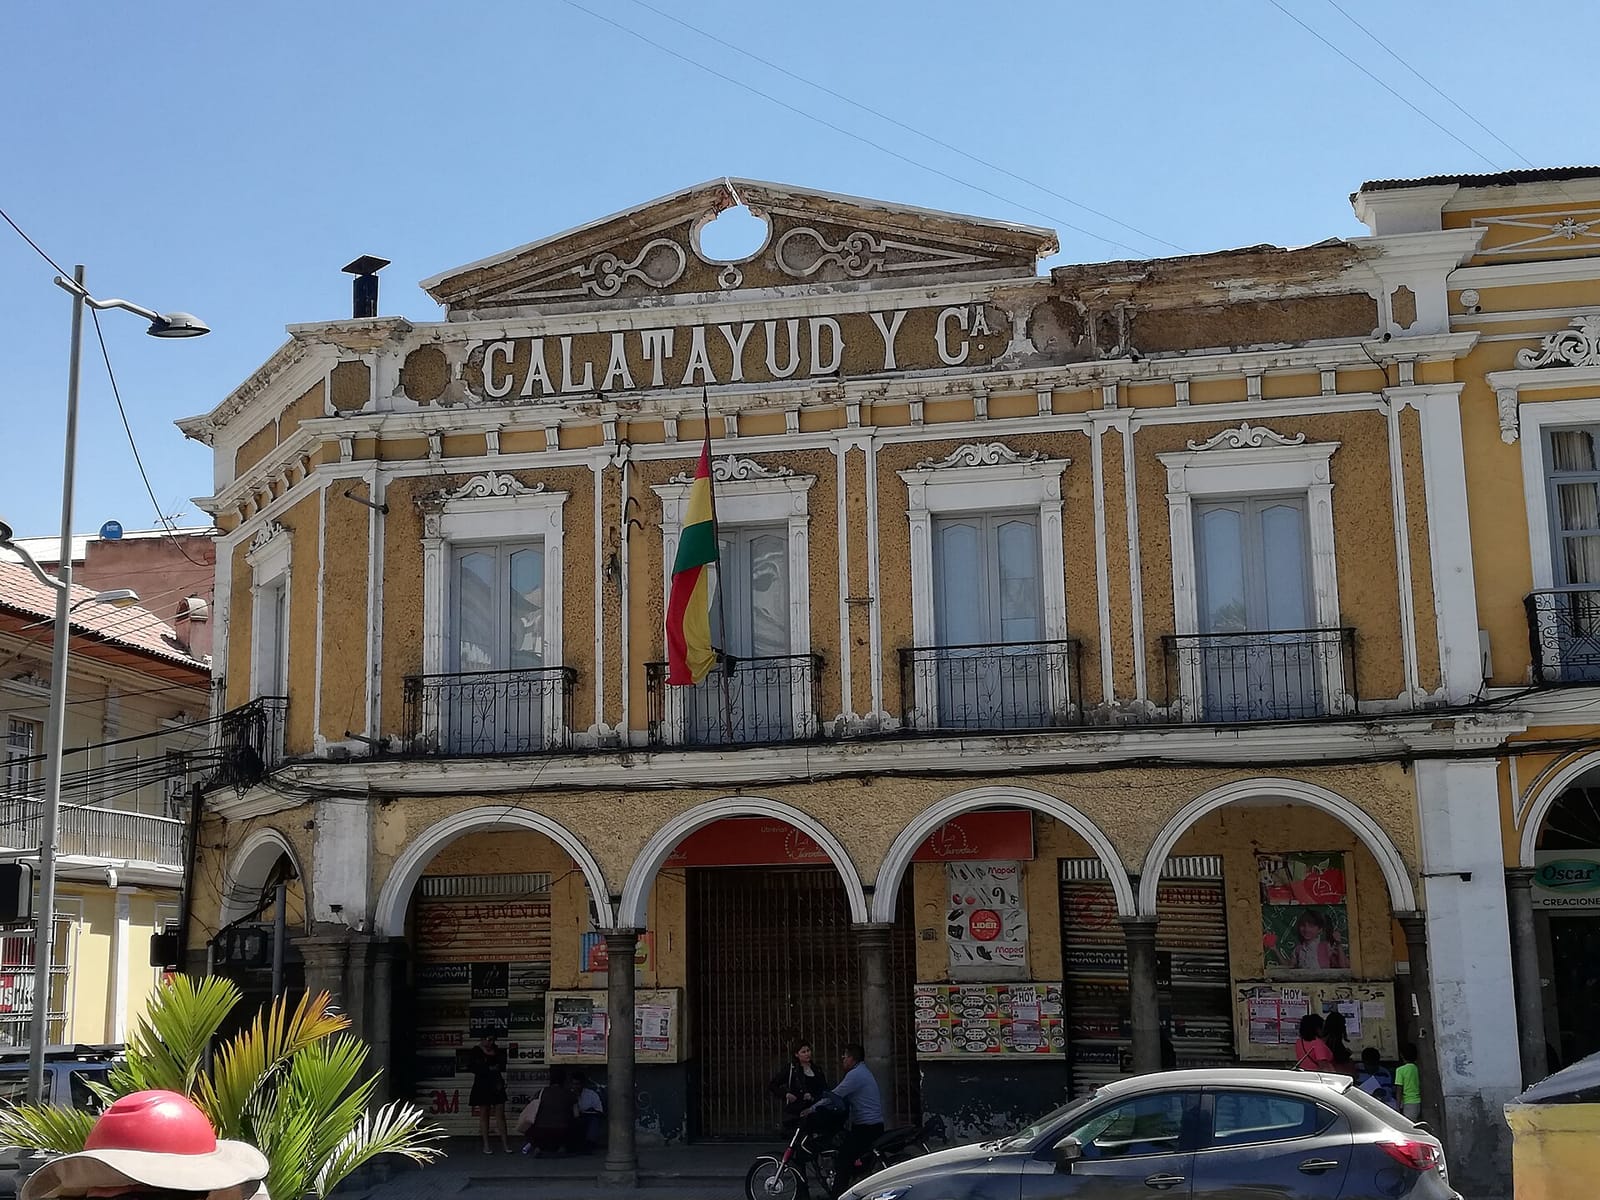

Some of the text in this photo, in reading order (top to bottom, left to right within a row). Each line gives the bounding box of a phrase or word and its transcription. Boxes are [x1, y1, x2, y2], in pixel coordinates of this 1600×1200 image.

[481, 317, 845, 398] CALATAYUD
[870, 311, 907, 370] Y
[971, 922, 998, 930] LIDER
[1018, 992, 1034, 1002] HOY
[1283, 989, 1300, 1000] HOY
[431, 1089, 459, 1114] 3M
